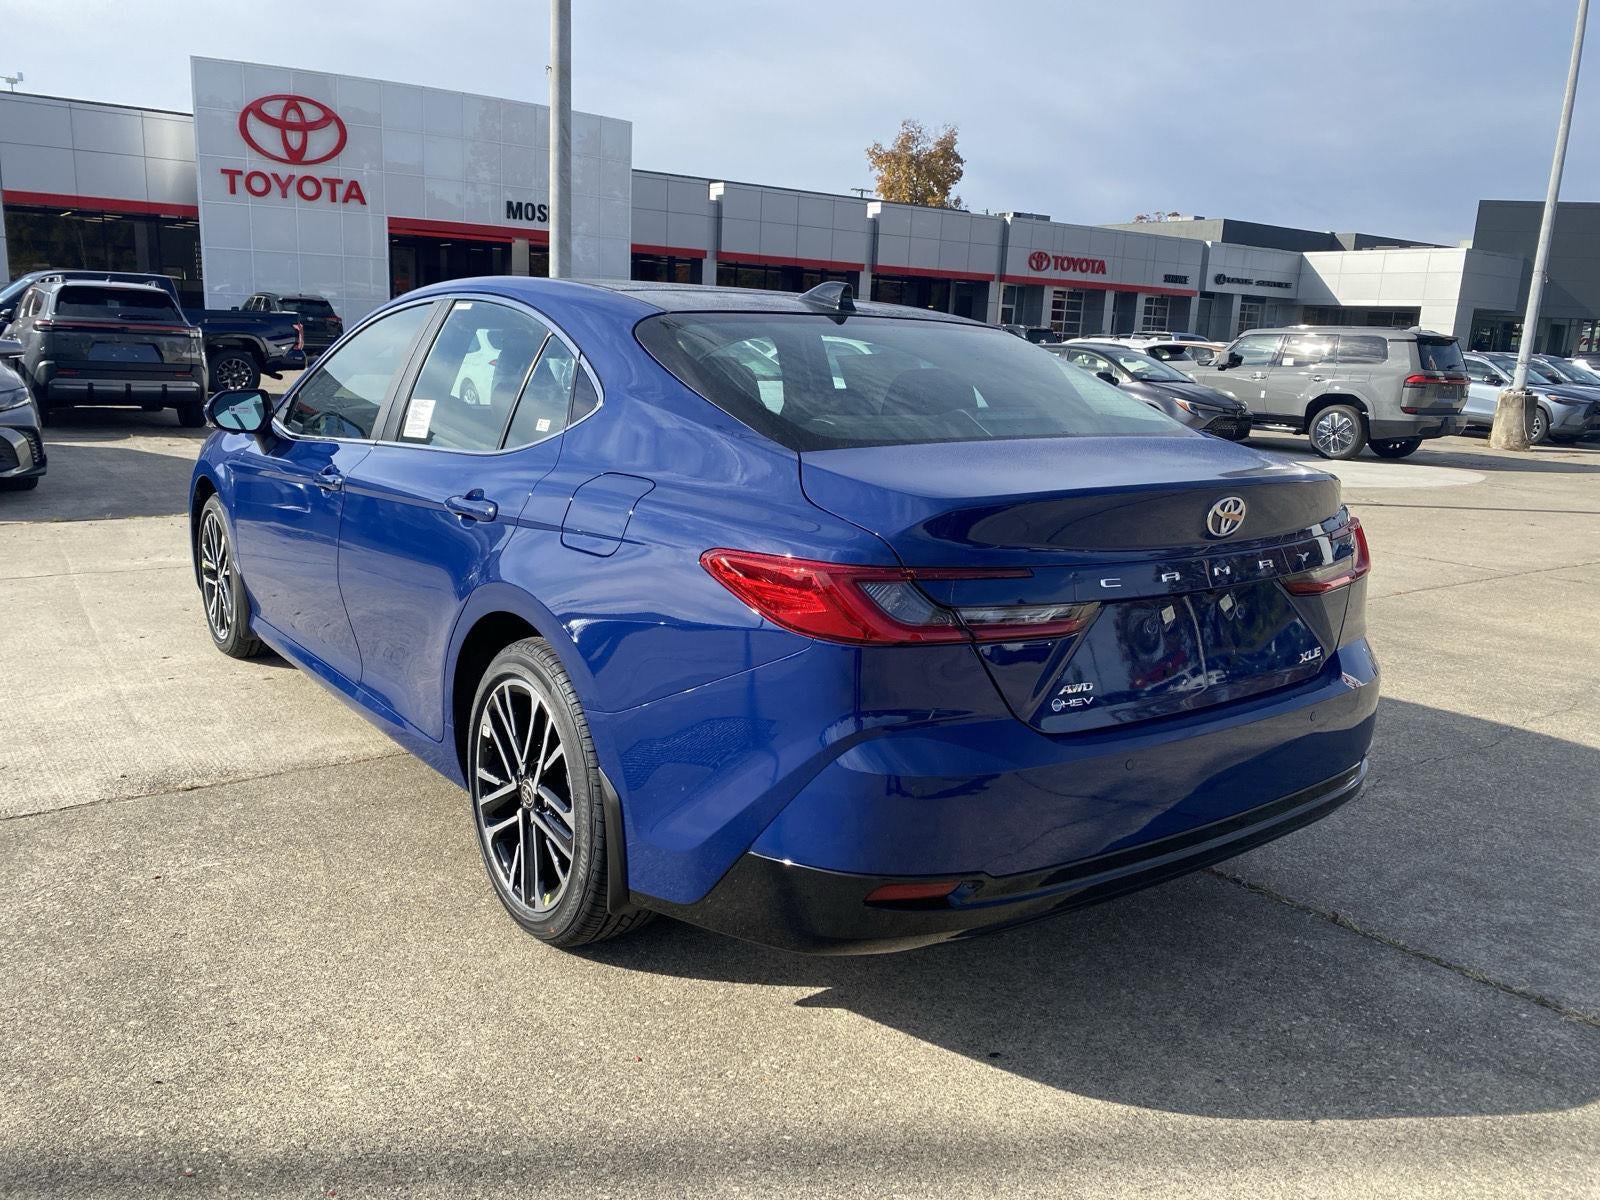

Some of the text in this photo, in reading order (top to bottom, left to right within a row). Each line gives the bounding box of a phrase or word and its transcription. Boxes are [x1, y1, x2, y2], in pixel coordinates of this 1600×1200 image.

[220, 168, 367, 206] TOYOTA
[506, 200, 550, 223] MOS
[1052, 255, 1106, 274] TOYOTA
[1100, 552, 1310, 588] CAMRY
[1299, 646, 1321, 664] XLE
[1058, 682, 1094, 696] AWD
[1061, 696, 1094, 708] HEV
